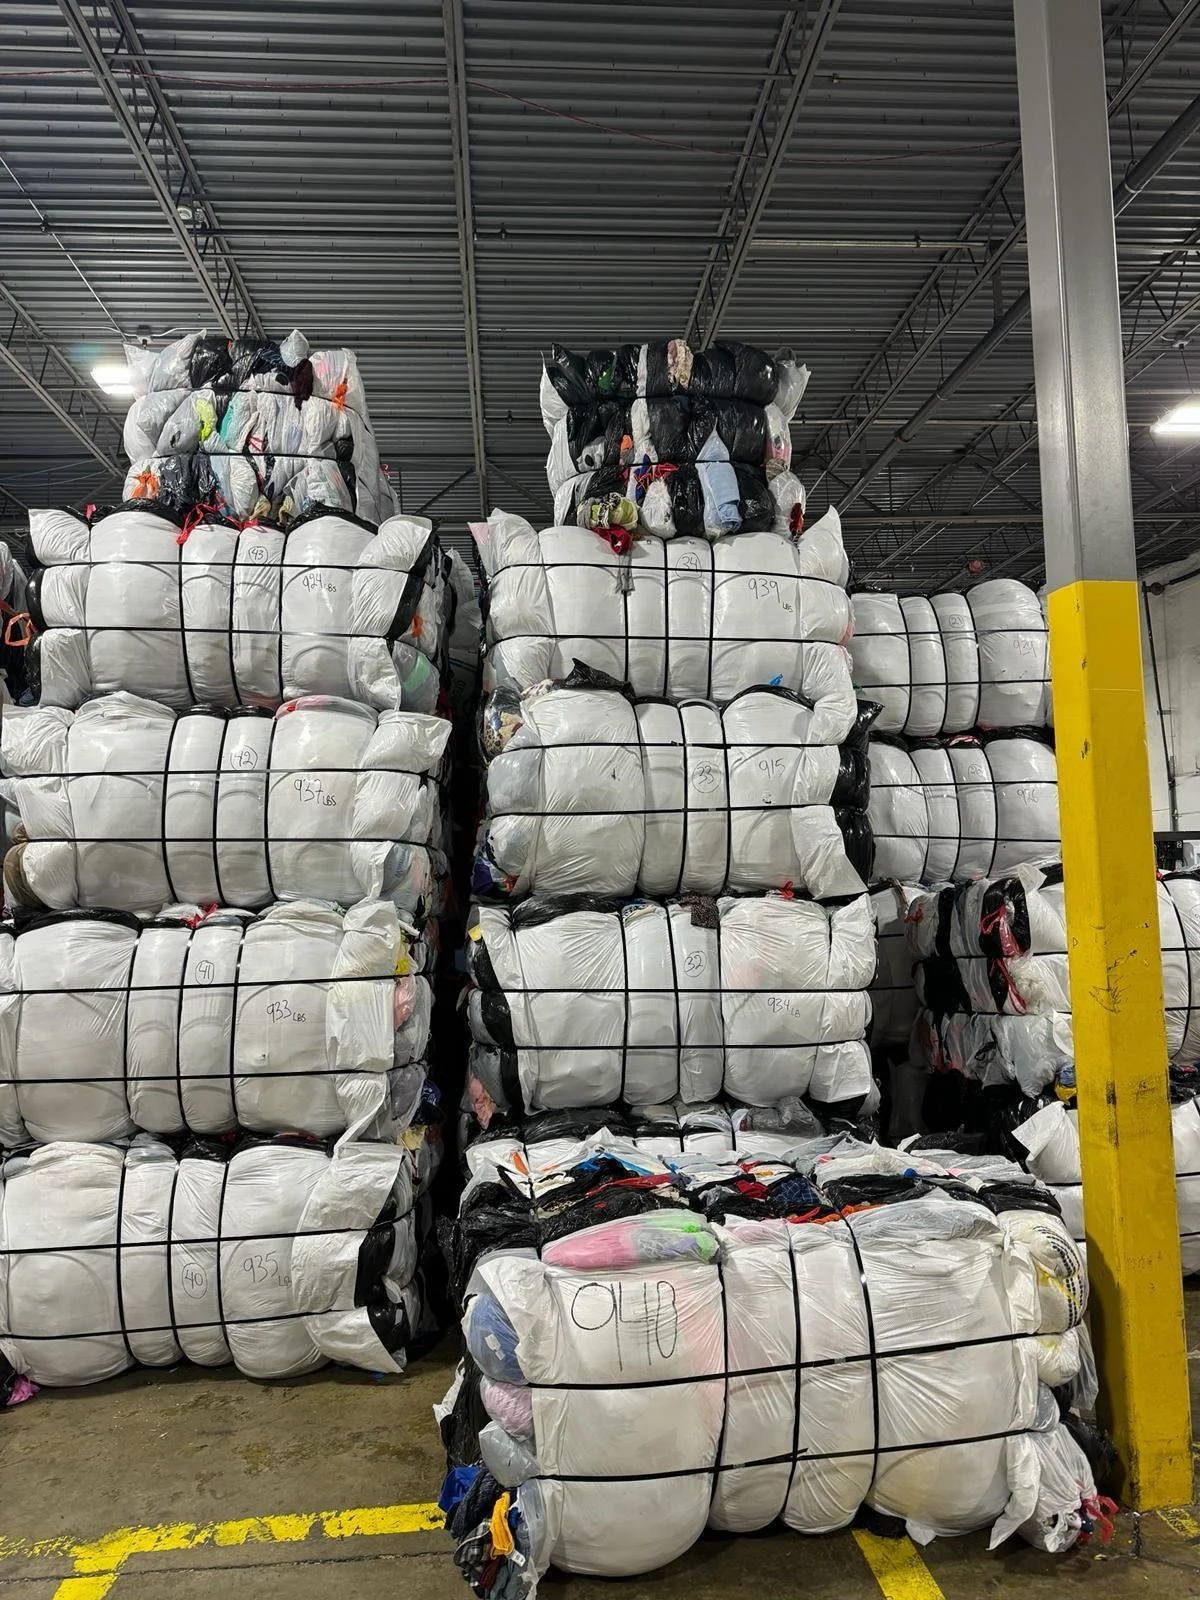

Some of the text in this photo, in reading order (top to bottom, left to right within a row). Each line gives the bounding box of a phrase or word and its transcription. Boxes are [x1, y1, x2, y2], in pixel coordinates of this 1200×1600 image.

[748, 578, 781, 603] 939
[759, 758, 786, 780] 915
[293, 778, 324, 804] 937
[266, 1000, 292, 1023] 933
[767, 997, 790, 1013] 934
[243, 1250, 279, 1283] 935
[571, 1281, 678, 1373] 940
